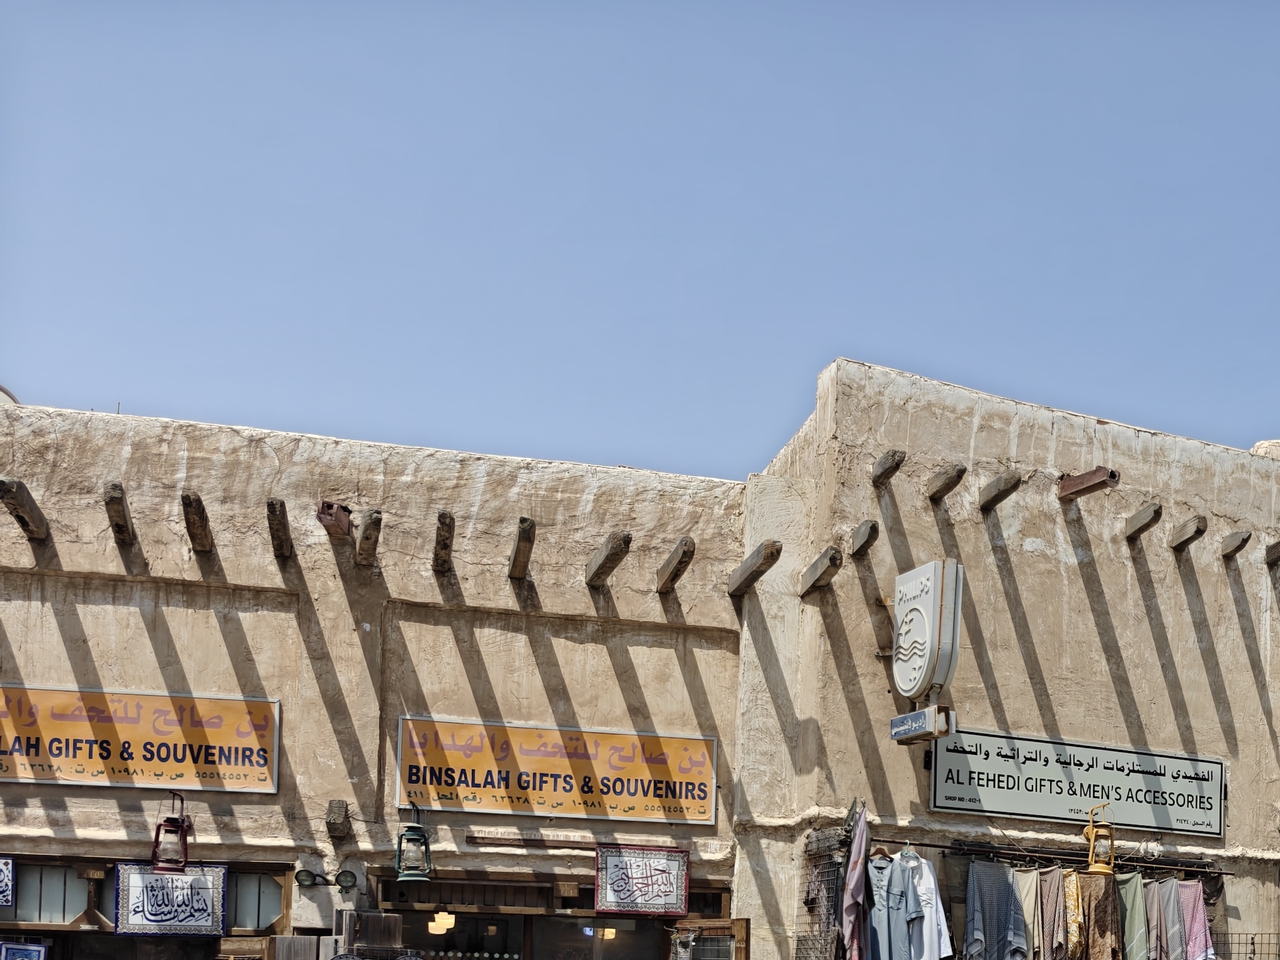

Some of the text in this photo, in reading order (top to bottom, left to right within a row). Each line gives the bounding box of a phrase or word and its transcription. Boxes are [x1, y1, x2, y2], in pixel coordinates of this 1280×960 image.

[897, 574, 931, 606] PHILIPS
[50, 696, 144, 725] للتحف
[152, 701, 224, 737] صالح
[235, 709, 270, 739] بن
[48, 737, 112, 760] GIFTS
[119, 741, 134, 762] &
[142, 742, 269, 768] SOUVENIRS
[408, 727, 707, 775] بن صالح للتحف والهدايا
[945, 742, 1214, 783] الفهيدي للمستلزمات الرجالية والتراثية والتحف
[407, 764, 708, 801] BINSALAH GIFTS & SOUVENIRS
[944, 768, 1214, 812] AL FEHEDI GIFTS & MEN'S ACCESSORIES
